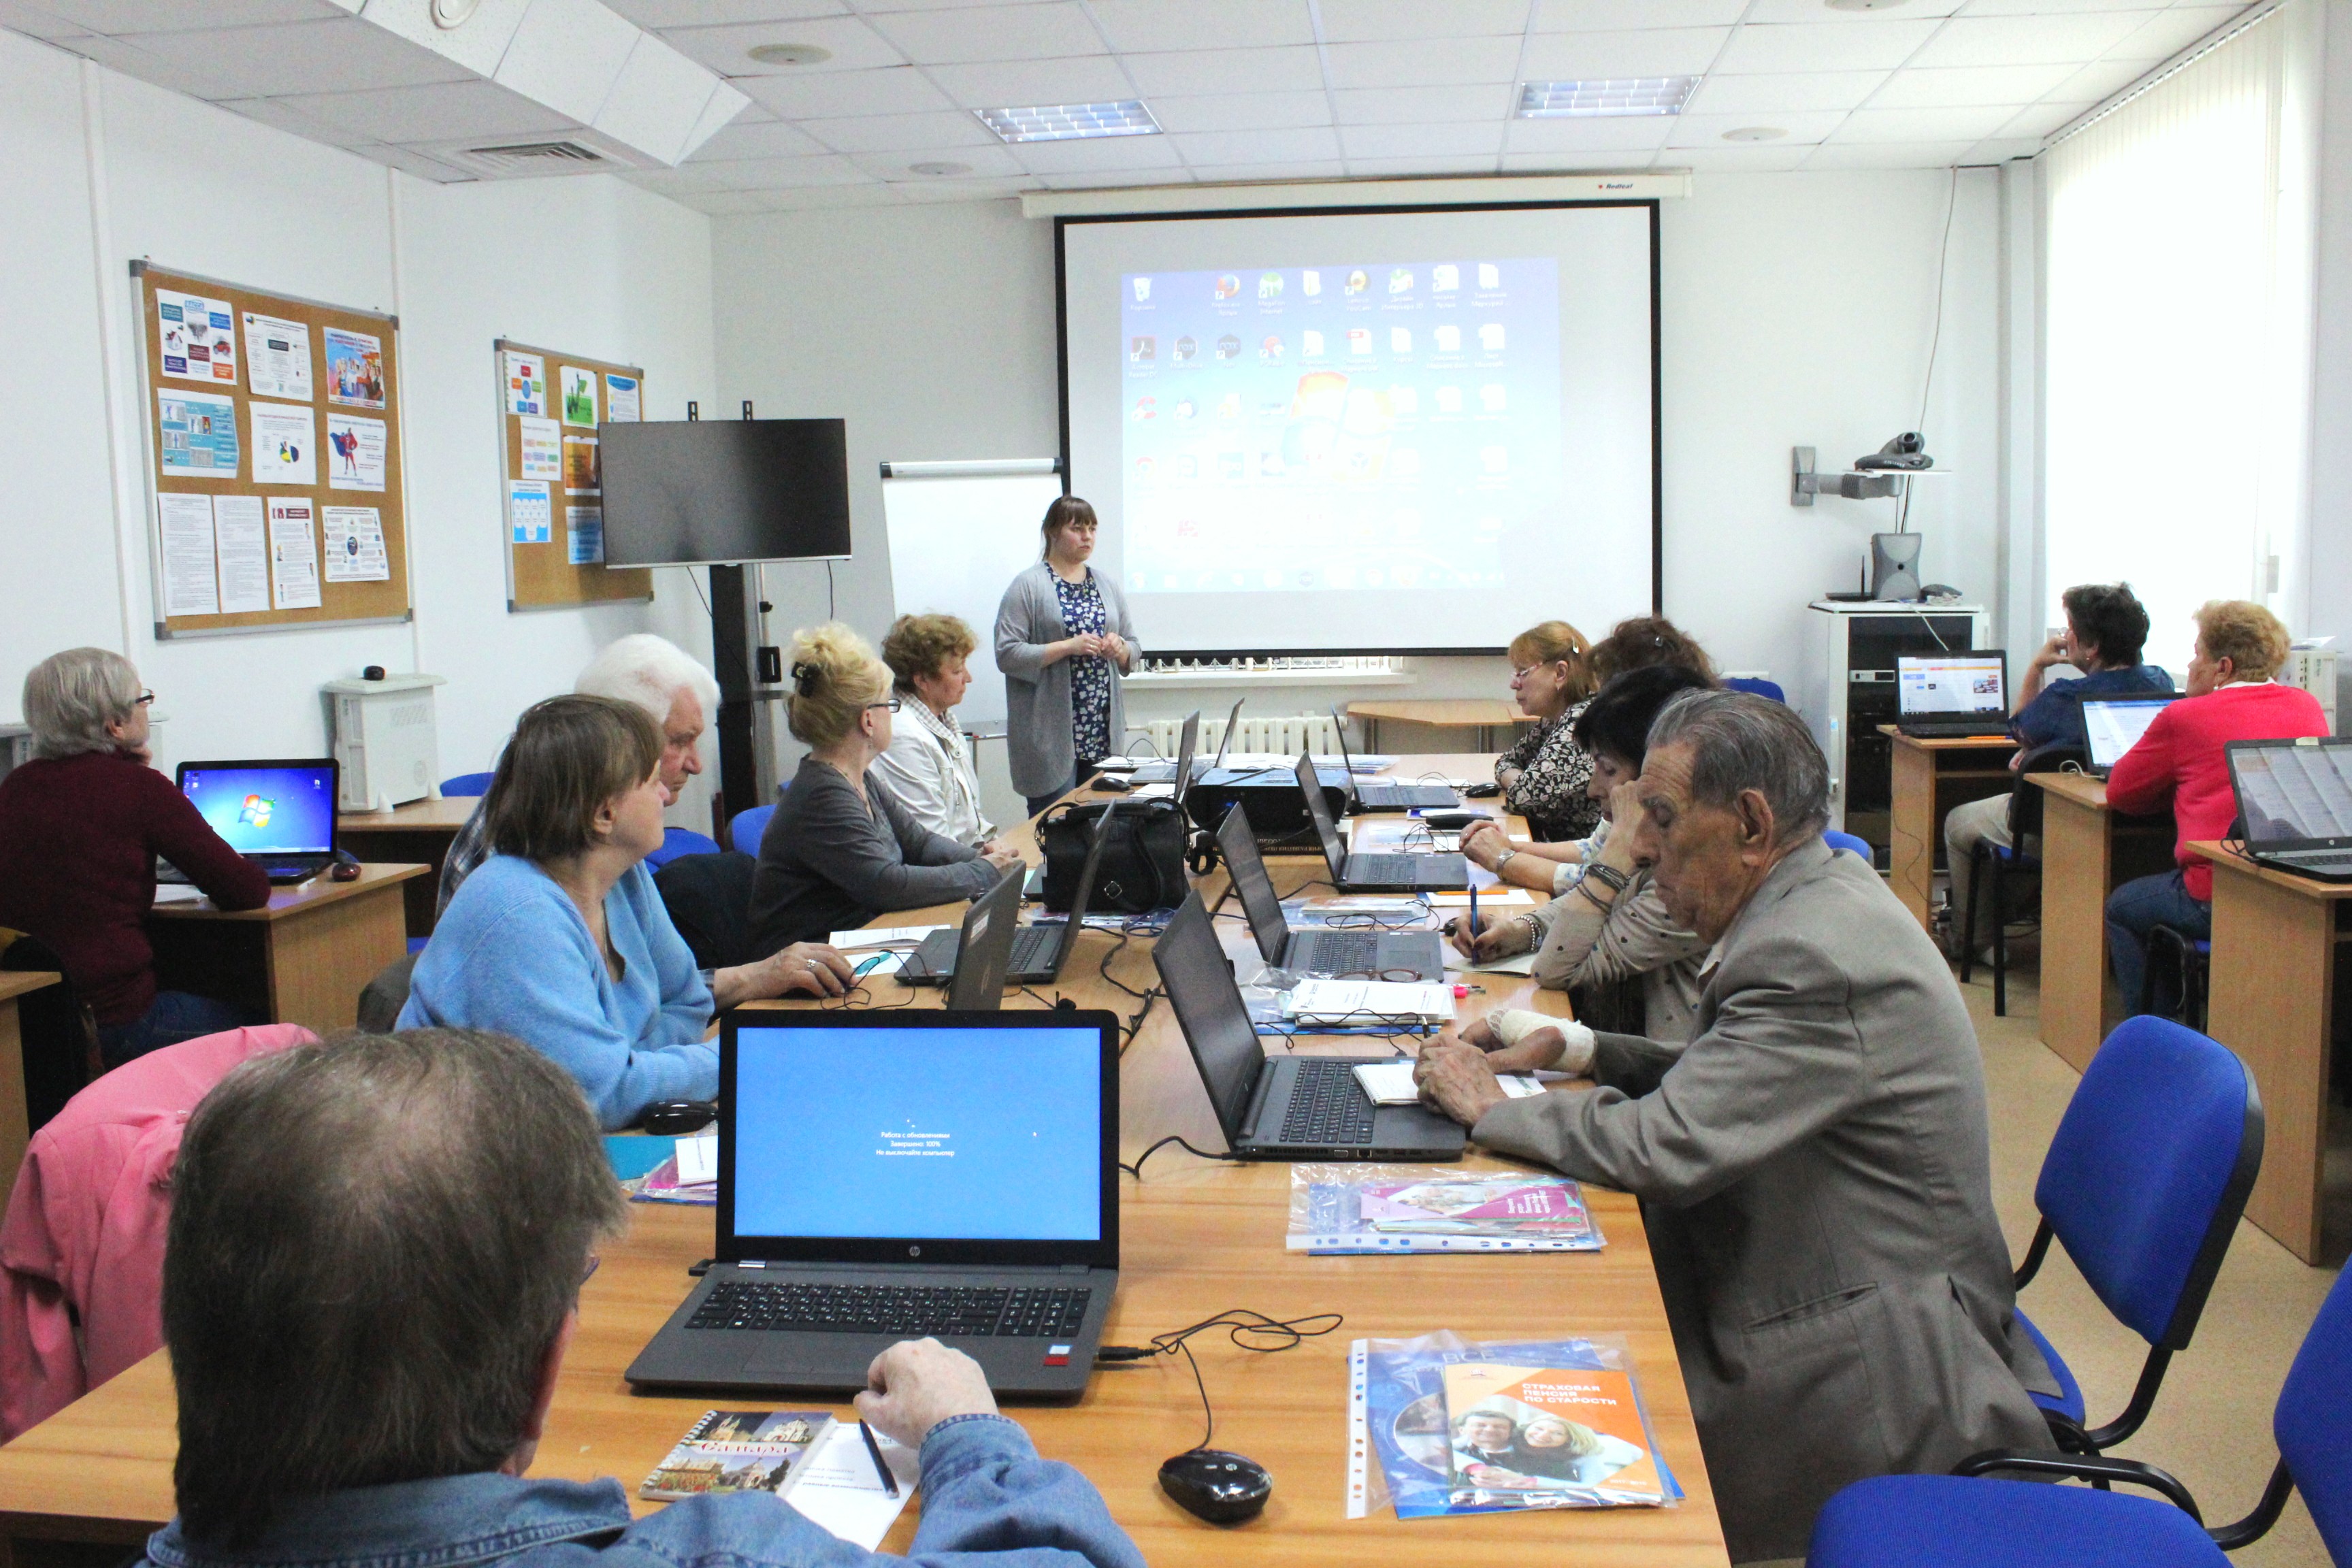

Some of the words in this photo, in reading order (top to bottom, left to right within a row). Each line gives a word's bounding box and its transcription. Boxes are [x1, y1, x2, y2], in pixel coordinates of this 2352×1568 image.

[1522, 1383, 1601, 1392] СТРАХОВАЯ
[1523, 1389, 1578, 1397] ПЕНСИЯ
[1547, 1397, 1617, 1405] СТАРОСТИ
[701, 1441, 790, 1456] Самара
